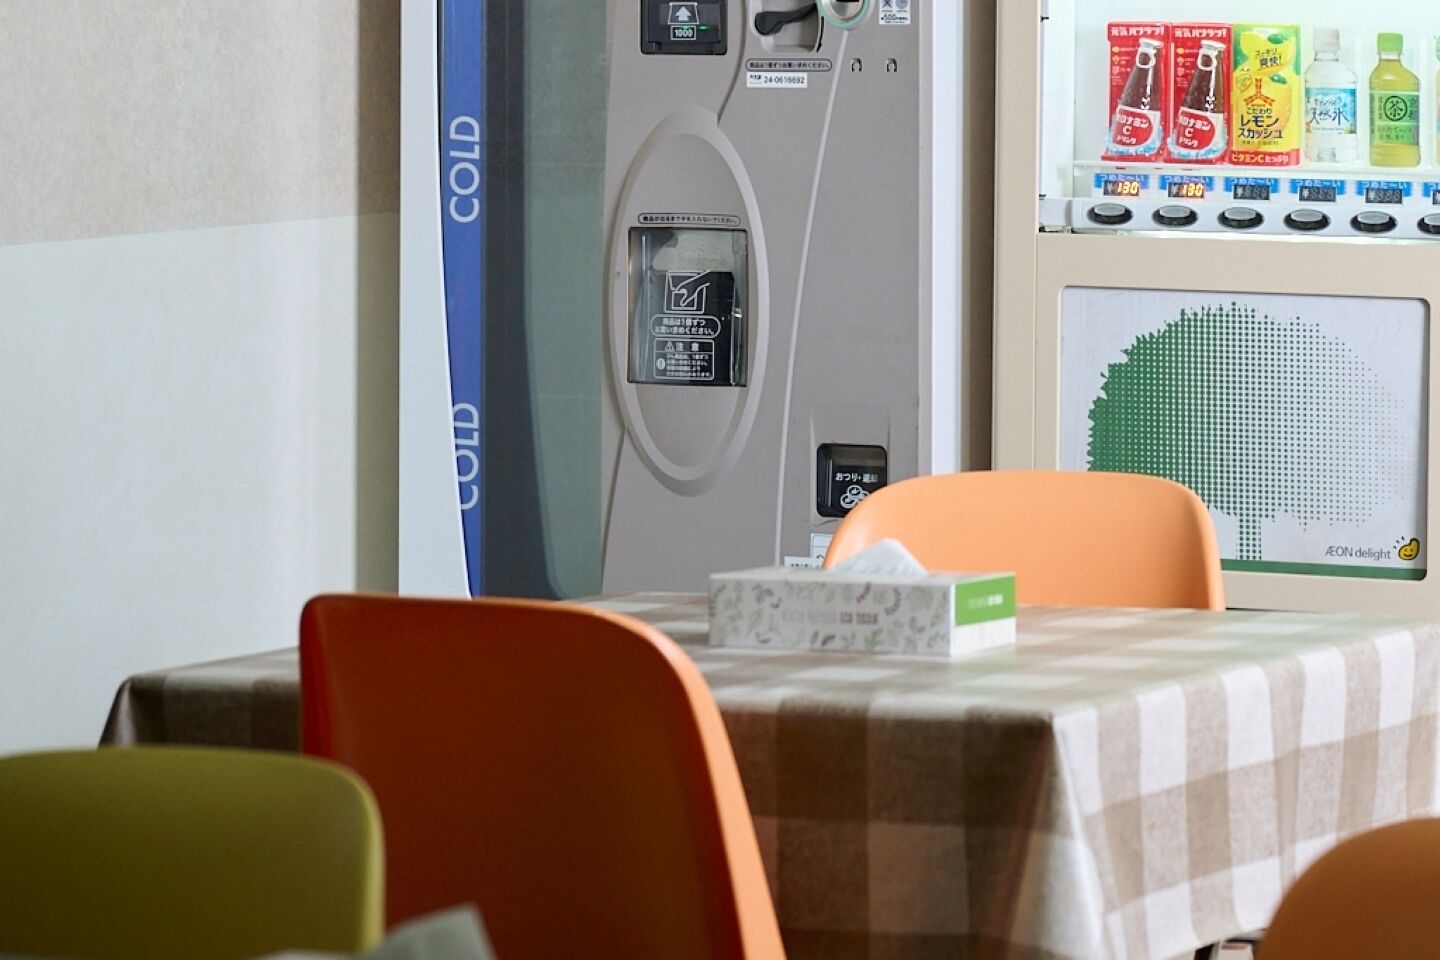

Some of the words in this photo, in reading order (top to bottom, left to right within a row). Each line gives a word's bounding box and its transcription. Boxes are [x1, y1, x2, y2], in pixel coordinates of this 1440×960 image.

[1259, 55, 1282, 69] 爽快!
[1246, 107, 1273, 115] こだわり
[1386, 97, 1404, 119] 茶
[1240, 114, 1280, 128] レモン
[1309, 107, 1351, 126] 天然水
[1122, 125, 1133, 136] C
[1184, 127, 1193, 138] C
[1238, 127, 1283, 139] スカッシュ
[1231, 153, 1289, 164] ビタミンCたっぷり
[449, 114, 480, 224] COLD
[458, 400, 480, 512] COLD
[1324, 545, 1354, 557] ÆON
[1354, 547, 1391, 561] delight
